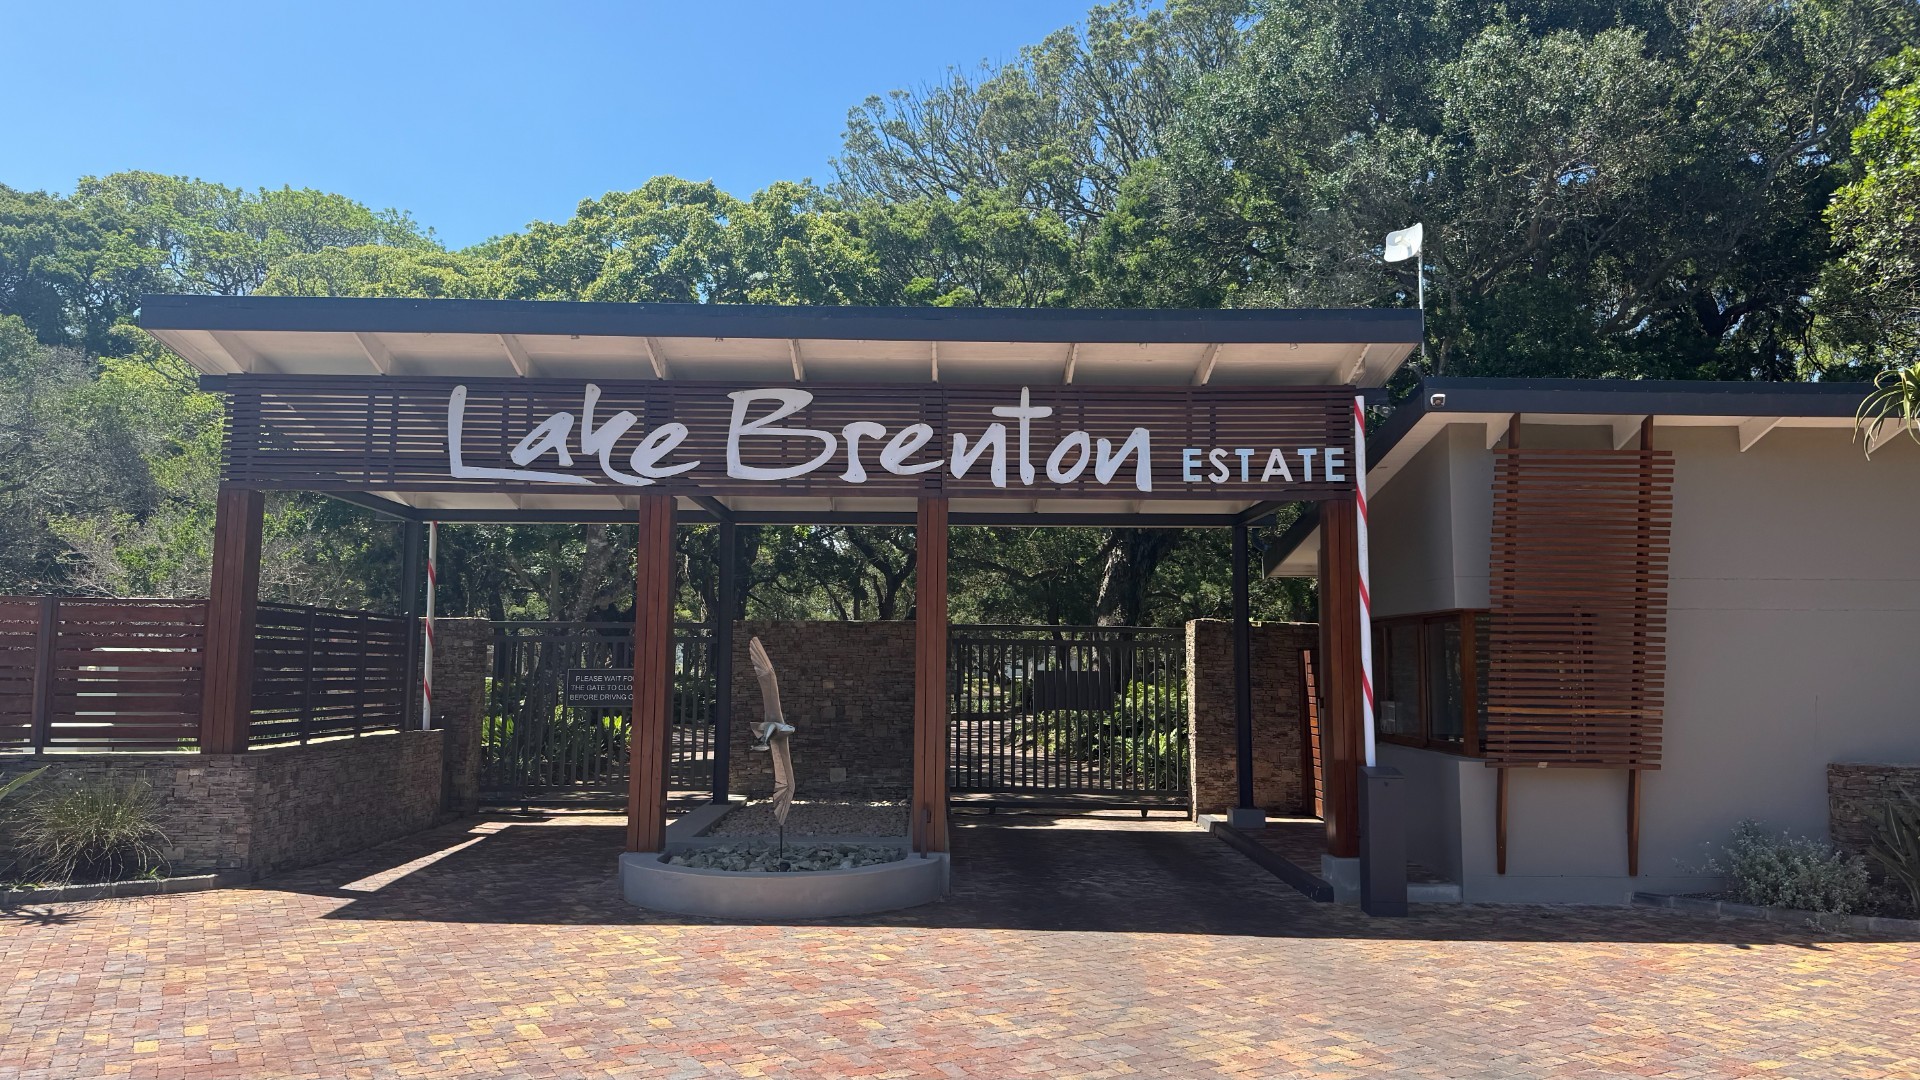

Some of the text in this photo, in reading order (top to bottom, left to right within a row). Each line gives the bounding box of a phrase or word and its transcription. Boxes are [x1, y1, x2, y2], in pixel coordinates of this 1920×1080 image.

[447, 384, 1345, 492] Lake Brenton ESTATE
